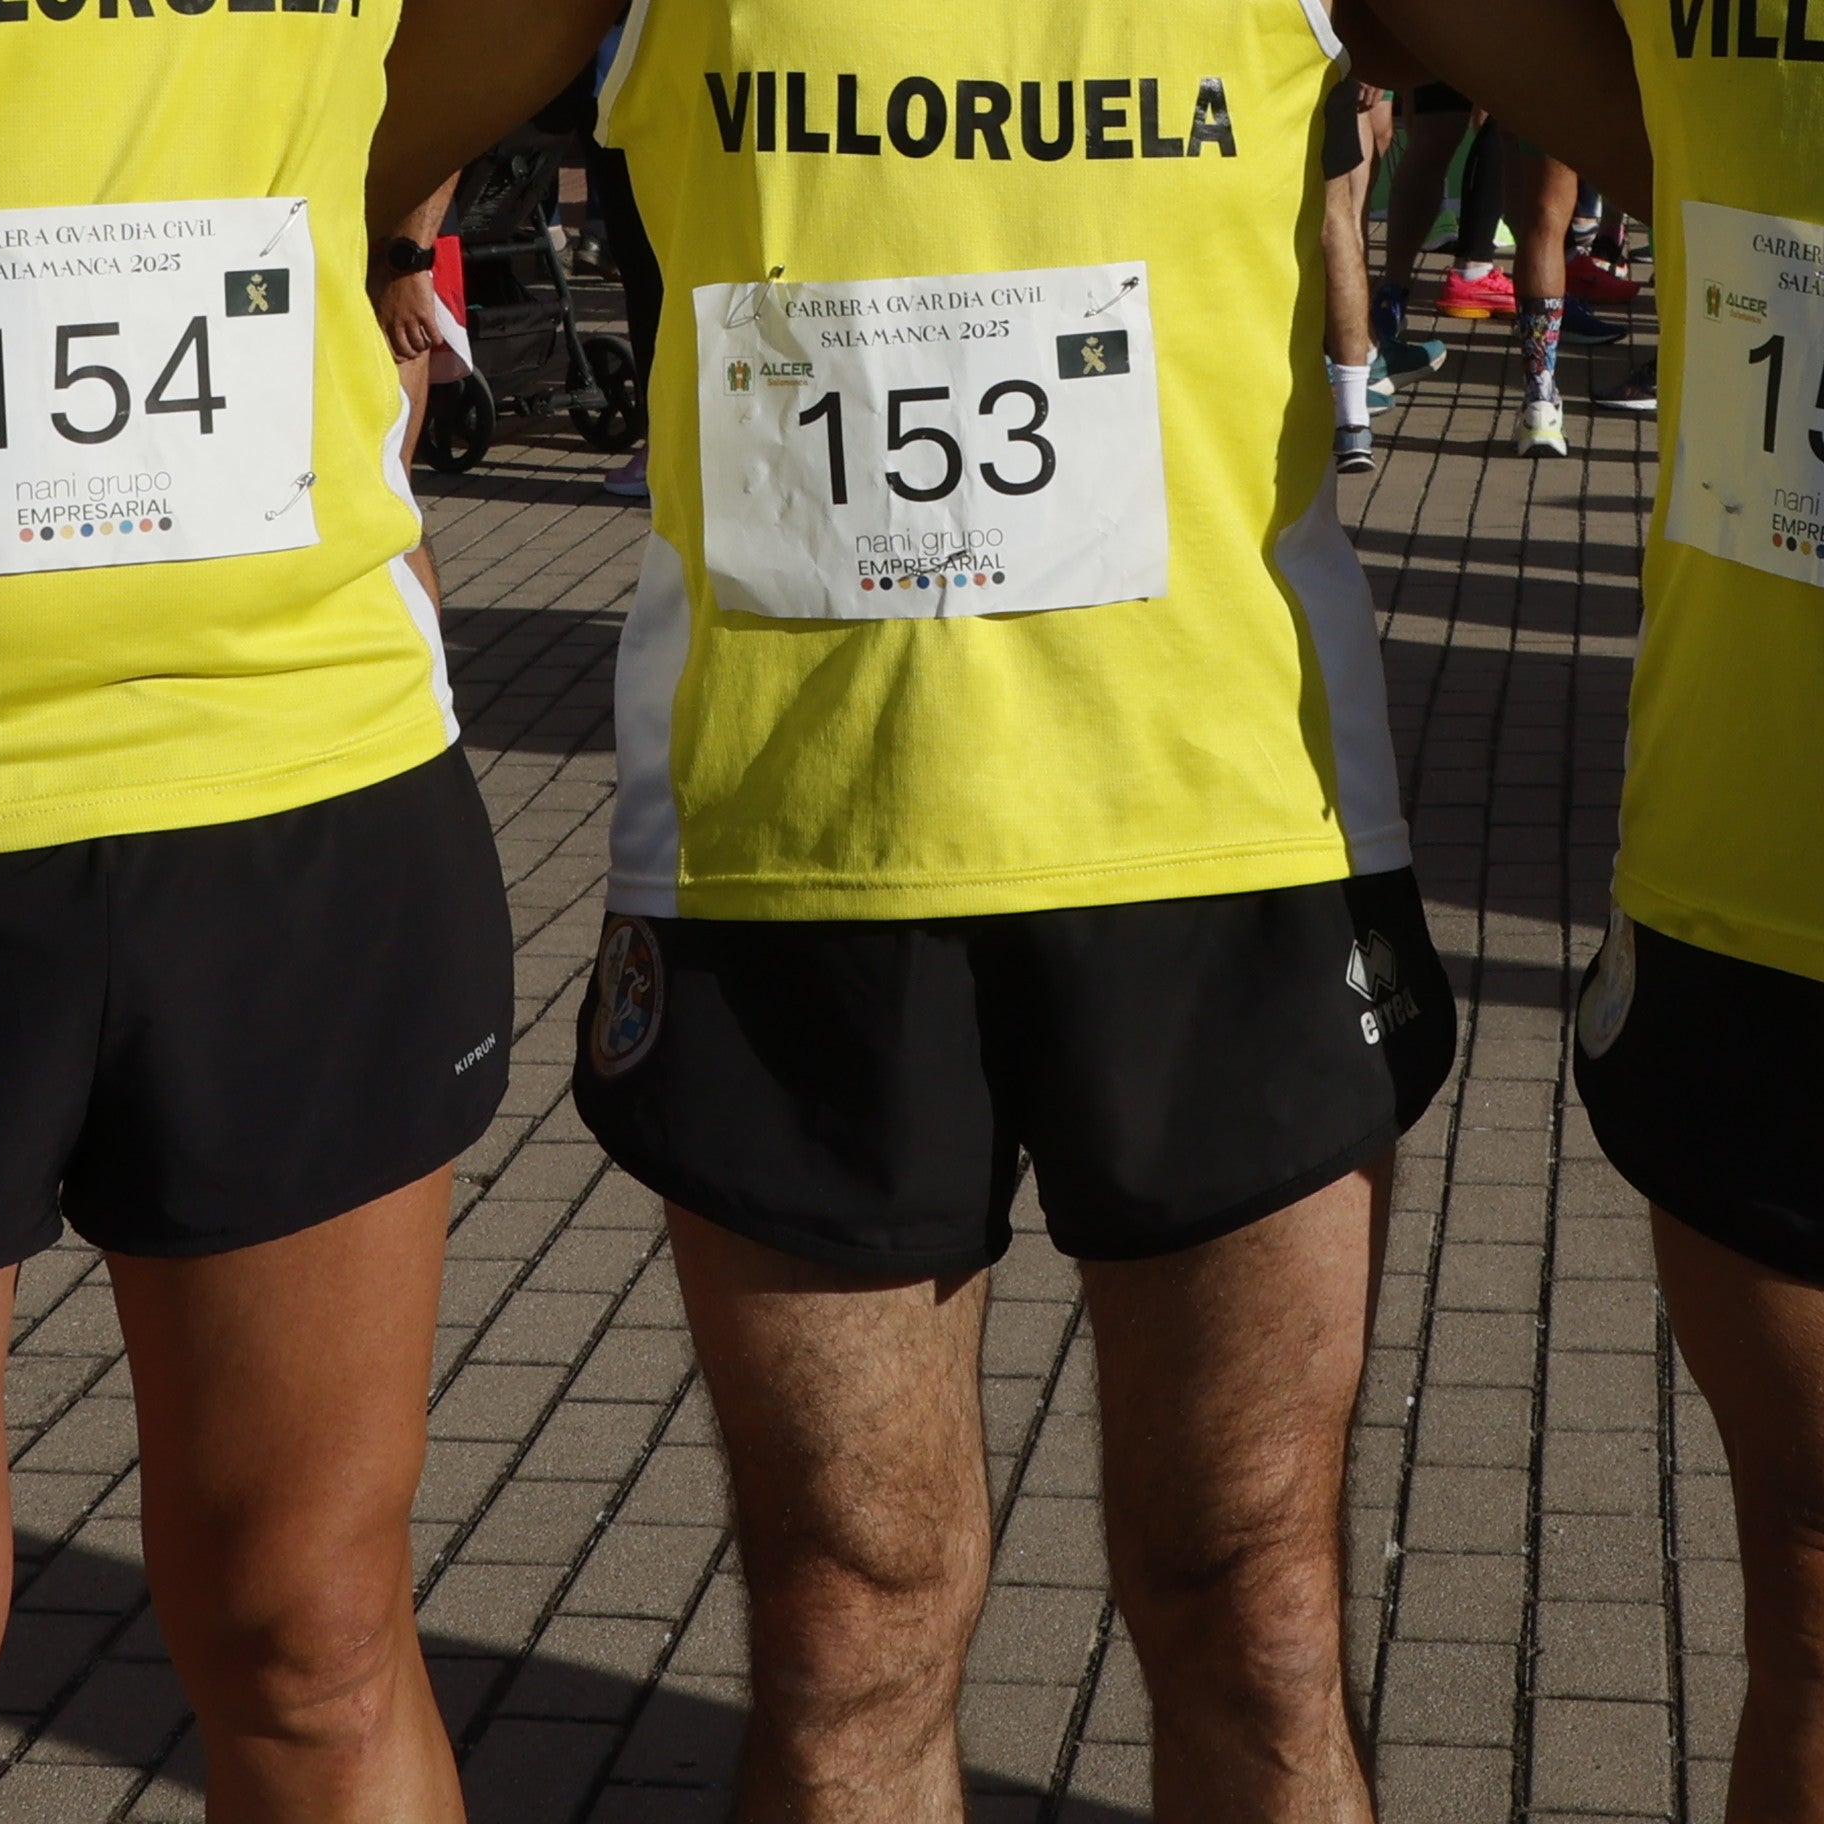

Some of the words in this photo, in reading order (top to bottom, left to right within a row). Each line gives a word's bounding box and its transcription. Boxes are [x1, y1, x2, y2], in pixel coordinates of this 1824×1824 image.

[704, 71, 1237, 161] VILLORUELA
[130, 252, 181, 273] 2025
[785, 298, 880, 319] CARRERA
[1725, 292, 1767, 317] ALCER
[821, 324, 950, 349] SALAMANCA
[959, 319, 1010, 340] 2025
[759, 362, 814, 378] ALCER
[798, 379, 1057, 505] 153
[16, 471, 76, 502] nani
[88, 469, 172, 507] grupo
[1774, 488, 1820, 516] nani
[17, 499, 173, 526] EMPRESARIAL
[855, 528, 912, 553] nani
[921, 528, 1004, 556] grupo
[858, 553, 1005, 576] EMPRESARIAL
[1360, 987, 1421, 1045] errea
[454, 1032, 496, 1076] KIPRUN
